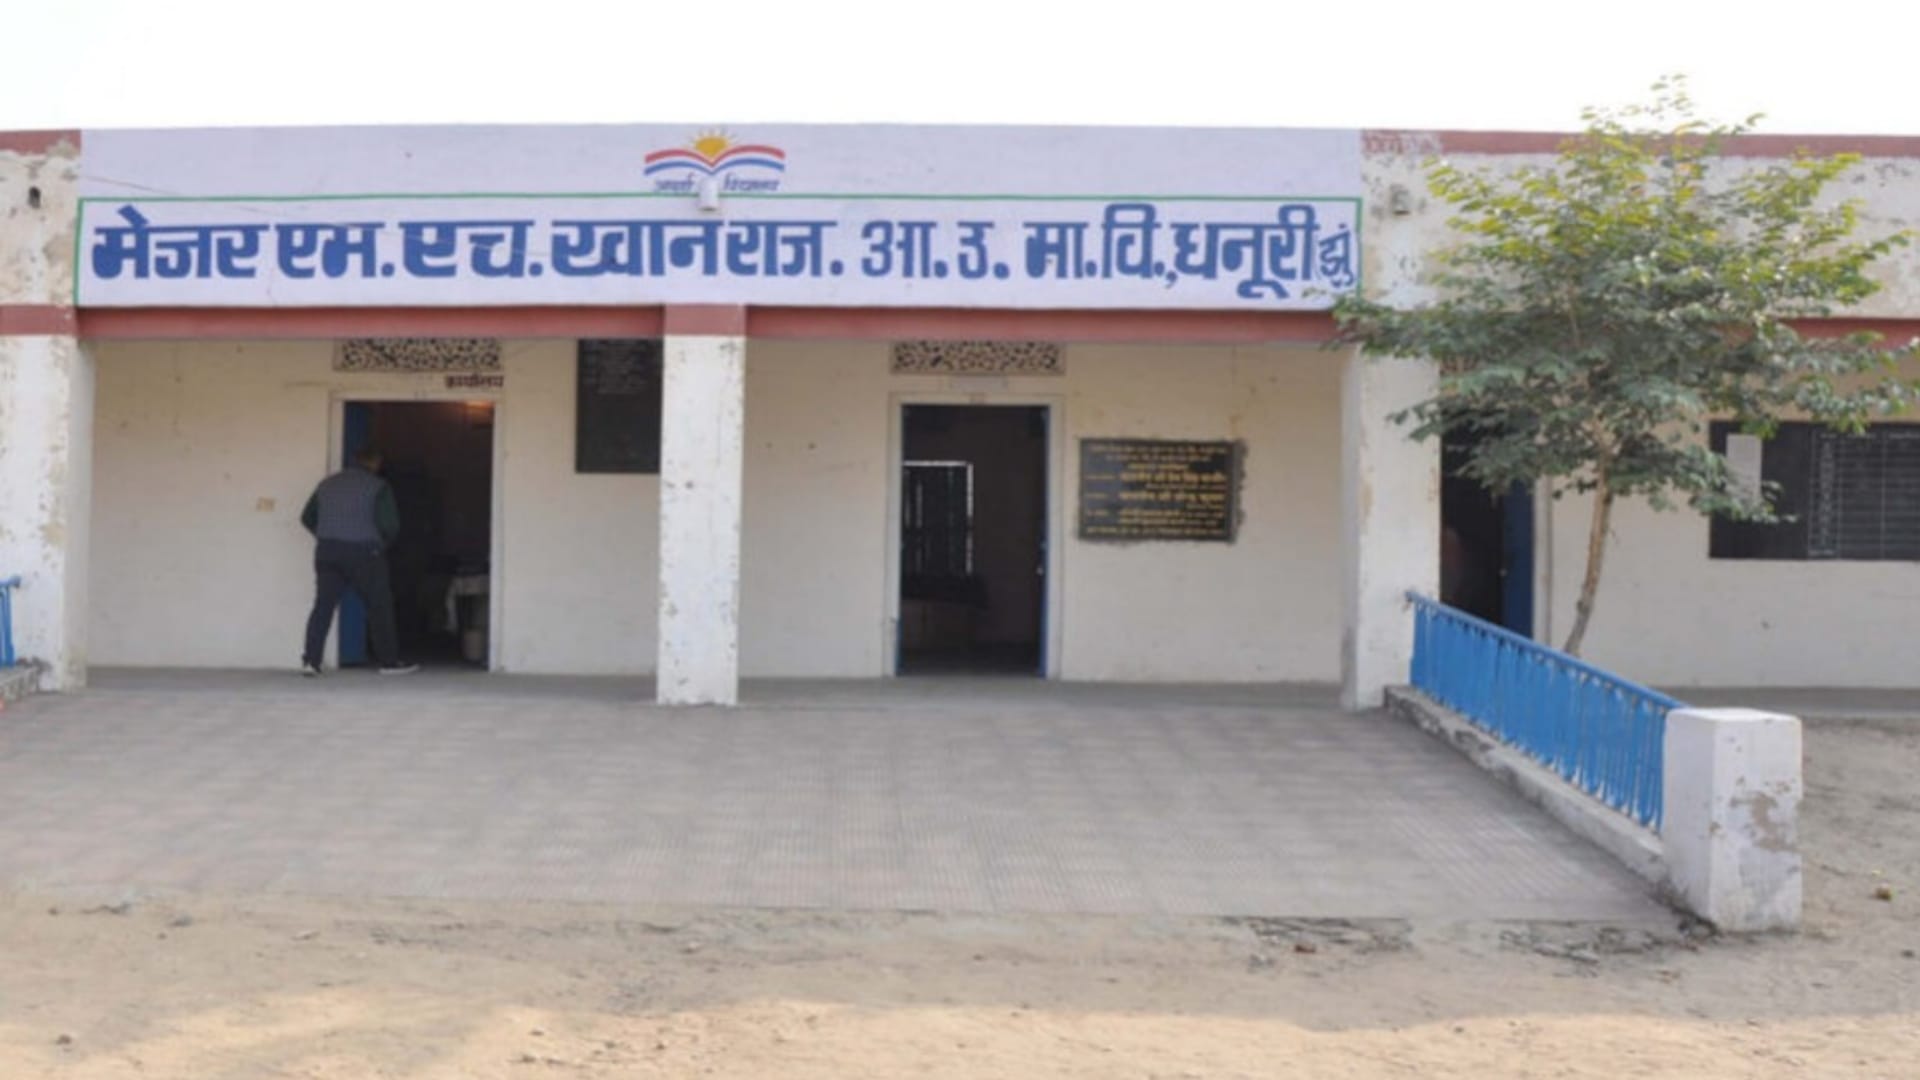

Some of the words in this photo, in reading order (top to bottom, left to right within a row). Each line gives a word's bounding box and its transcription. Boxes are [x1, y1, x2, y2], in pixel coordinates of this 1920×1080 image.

[92, 204, 270, 279] मेजर
[275, 221, 395, 279] एम.
[398, 219, 543, 278] एच.
[551, 219, 724, 277] खान
[725, 220, 844, 277] राज.
[861, 220, 949, 279] आ.
[957, 221, 1011, 279] उ.
[1022, 221, 1098, 279] मा.
